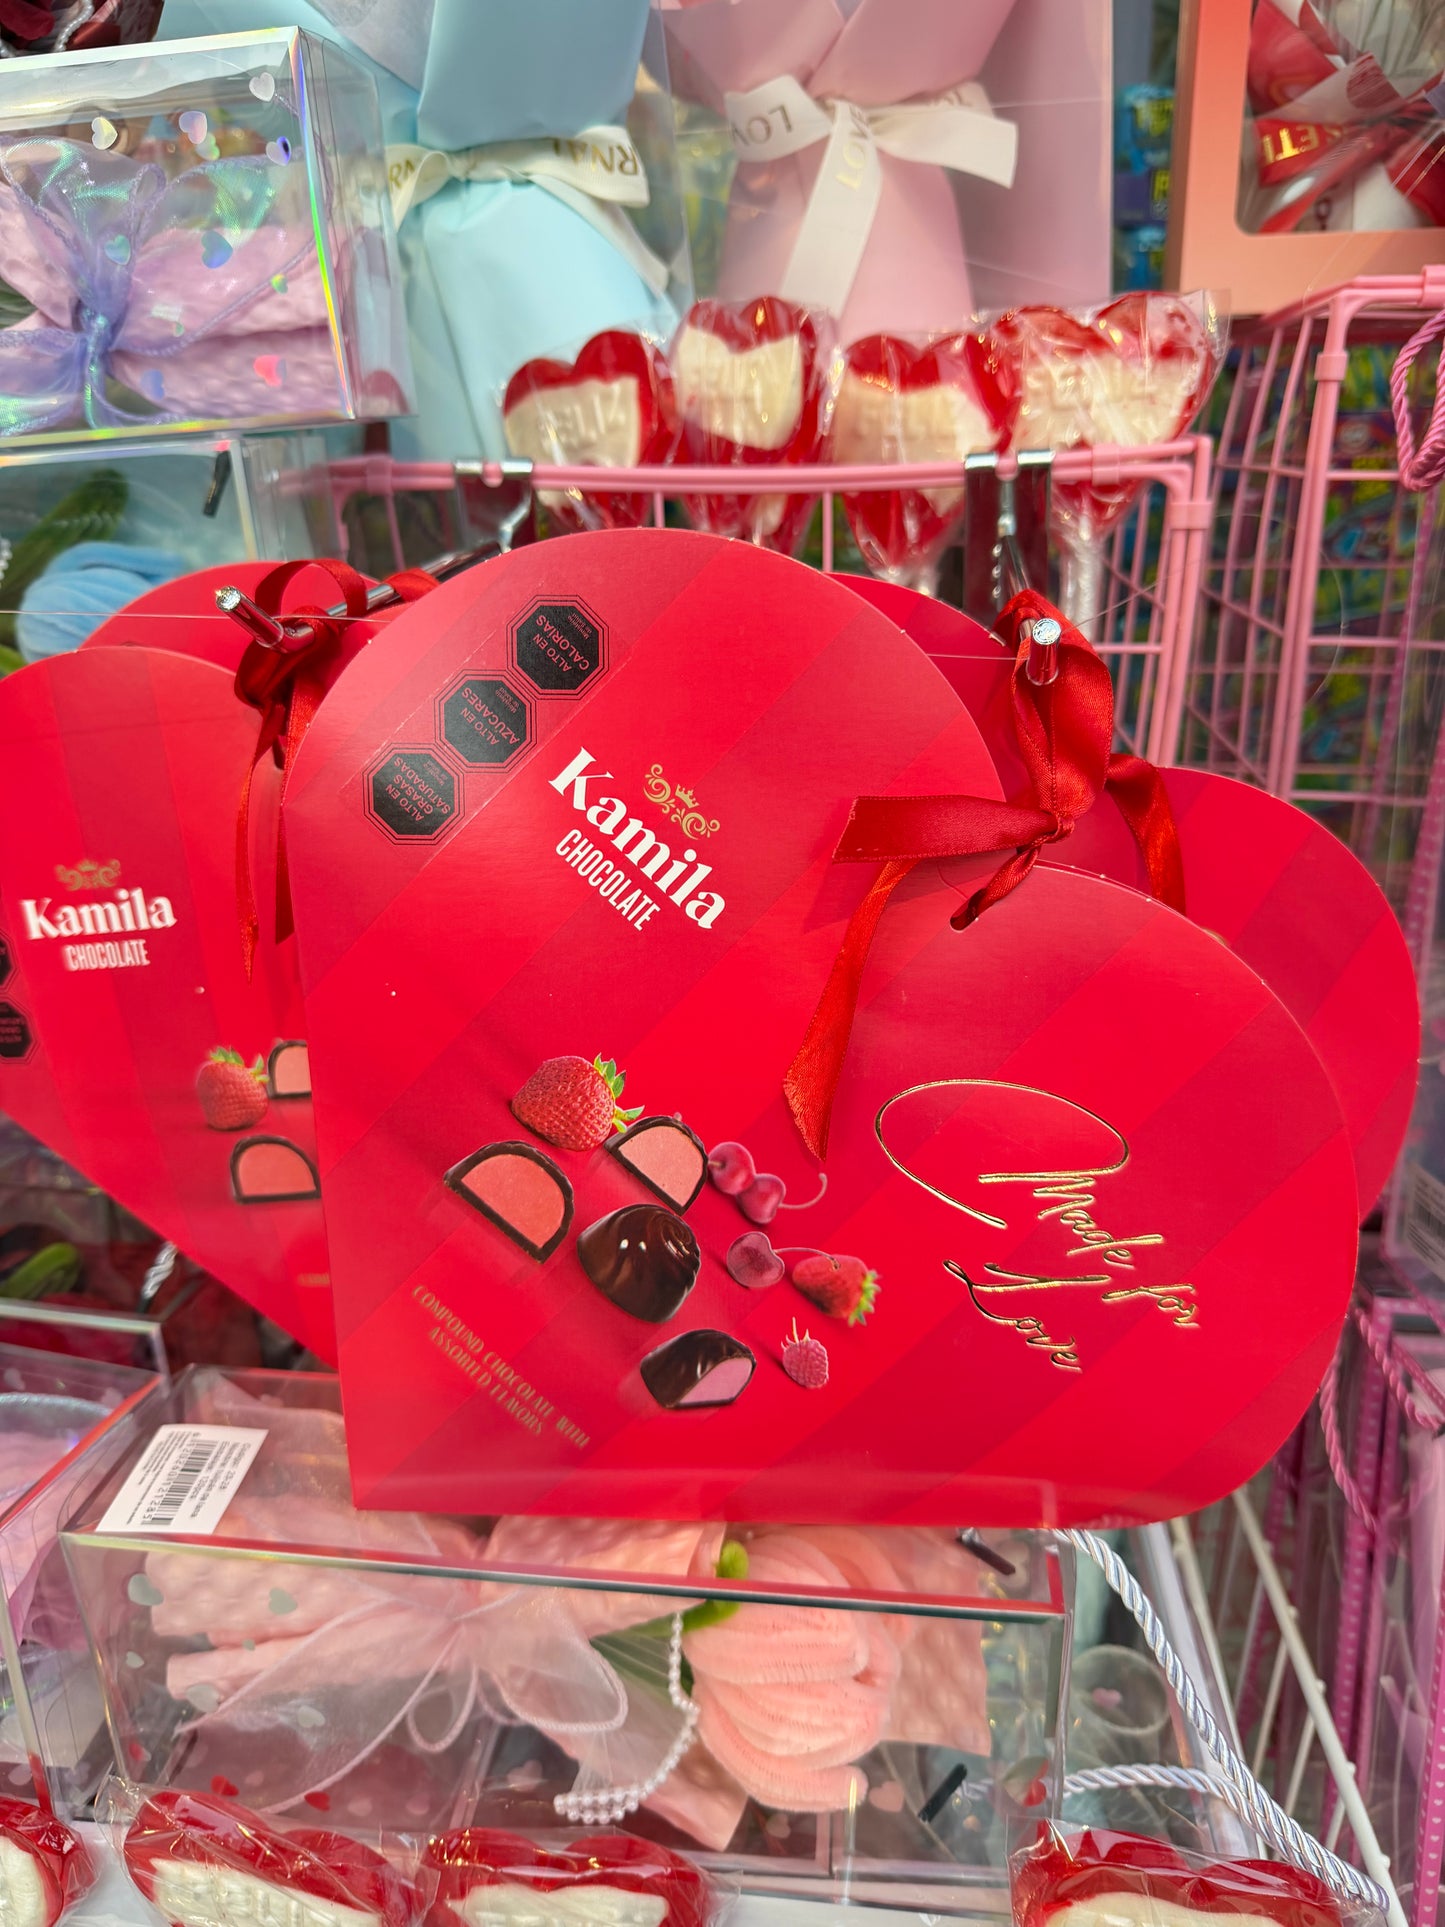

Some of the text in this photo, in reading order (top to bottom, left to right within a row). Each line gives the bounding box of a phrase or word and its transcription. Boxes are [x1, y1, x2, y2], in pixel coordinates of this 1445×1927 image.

[533, 634, 571, 672] ALTO EN
[535, 614, 590, 670] CALORÍAS
[461, 708, 498, 745] ALTO EN
[462, 687, 519, 745] AZÚCARES
[386, 784, 424, 821] ALTO EN
[393, 774, 434, 815] GRASAS
[394, 757, 450, 814] SATURADAS
[549, 746, 727, 930] Kamila
[555, 829, 661, 931] CHOCOLATE
[21, 887, 178, 940] Kamila
[64, 939, 151, 972] CHOCOLATE
[875, 1079, 1200, 1328] Made for
[943, 1259, 1112, 1372] Love
[412, 1285, 591, 1448] COMPOUND CHOCOLATE WITH
[429, 1326, 543, 1435] ASSORTED FLAVORS
